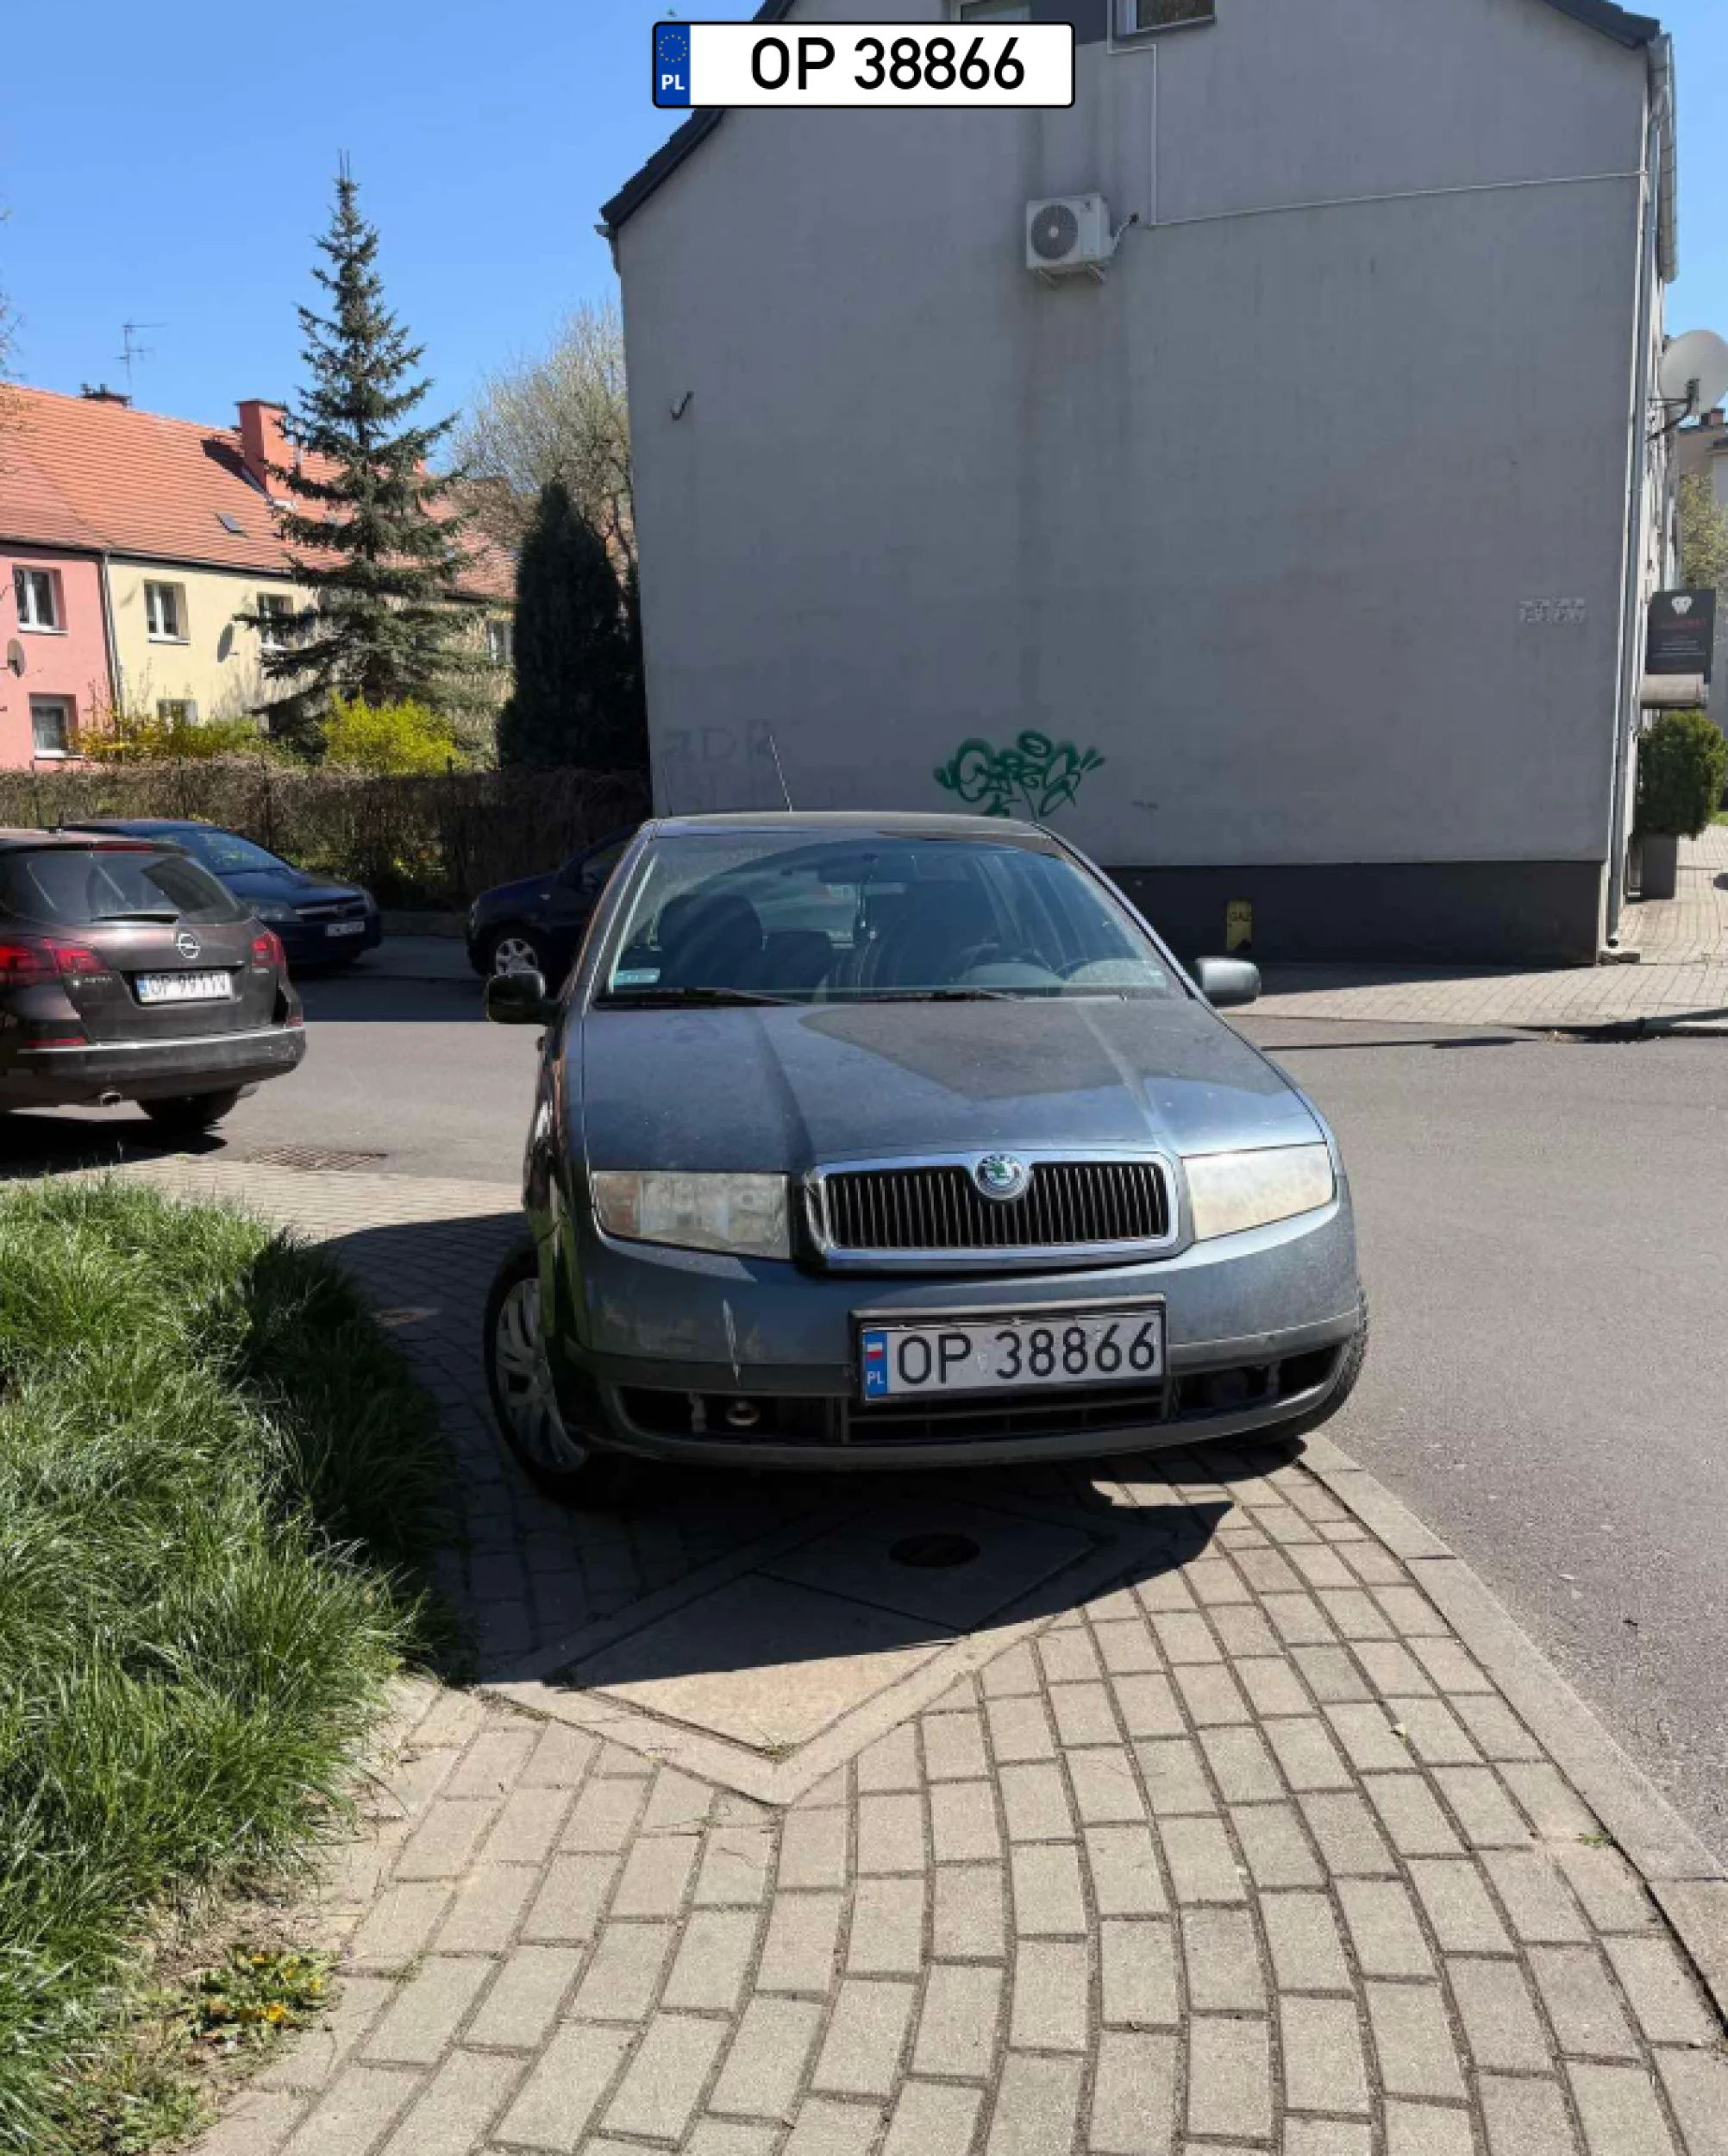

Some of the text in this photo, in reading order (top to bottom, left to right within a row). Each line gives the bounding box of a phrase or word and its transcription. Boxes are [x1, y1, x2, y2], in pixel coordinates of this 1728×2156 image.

[897, 1321, 1155, 1385] OP 38866
[866, 1371, 886, 1385] PL
